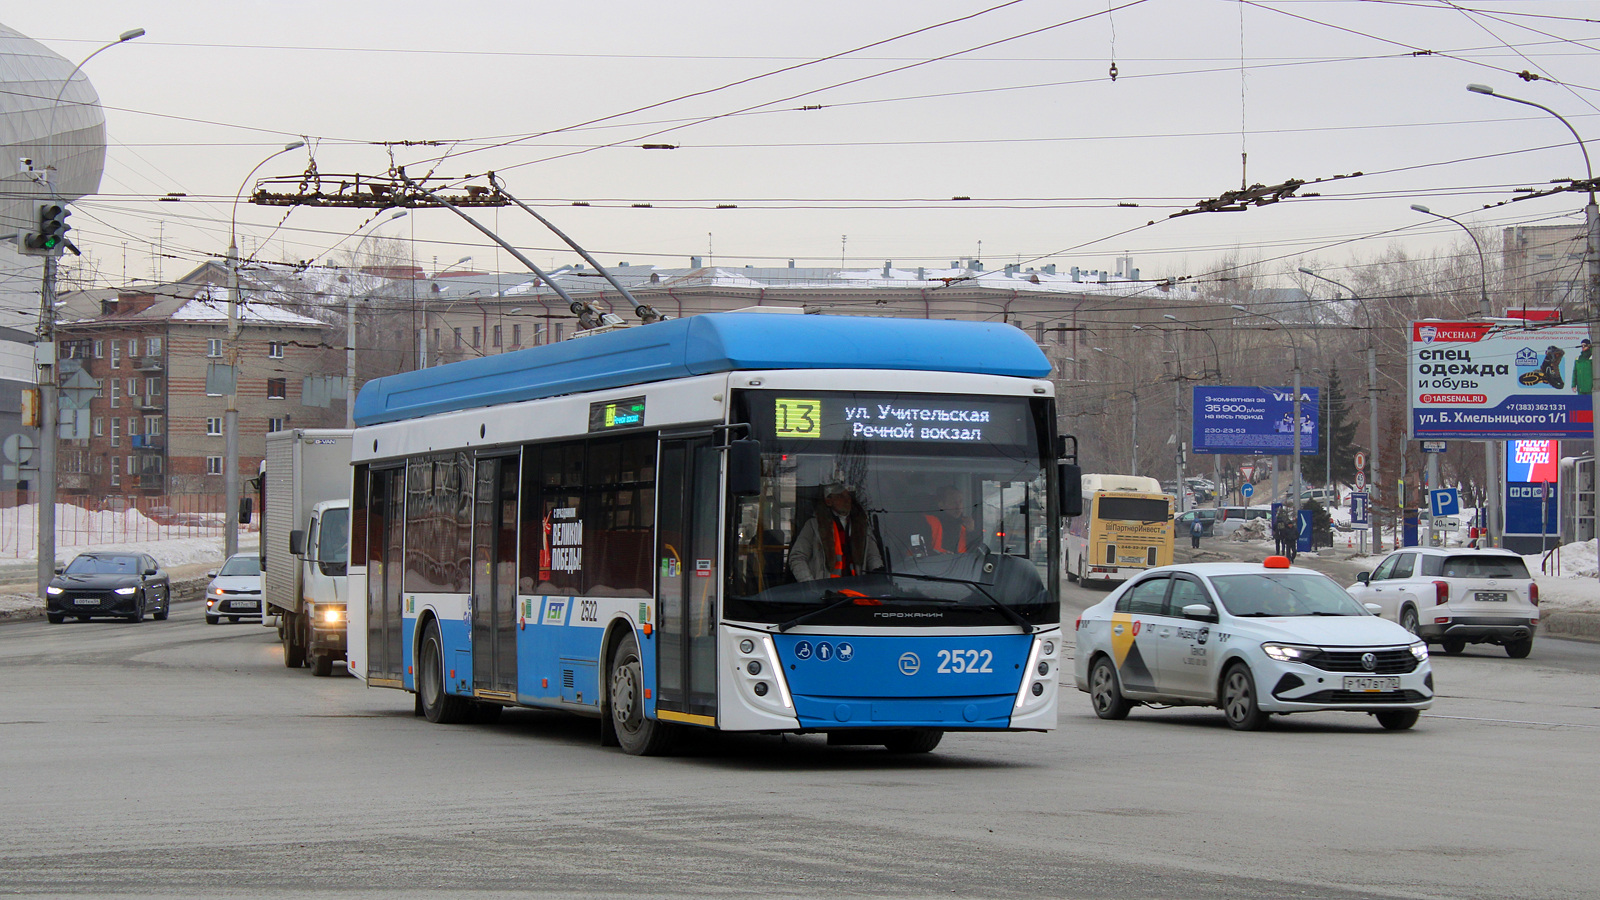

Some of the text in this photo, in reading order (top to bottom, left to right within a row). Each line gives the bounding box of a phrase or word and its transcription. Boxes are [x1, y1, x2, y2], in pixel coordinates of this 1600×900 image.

[1436, 331, 1477, 339] АРСЕНАЛ
[1419, 349, 1471, 362] спец
[1419, 364, 1509, 376] одежда
[1419, 378, 1479, 391] и обувь
[1433, 395, 1484, 403] 1ARSENAL.RU
[845, 404, 990, 423] ул. Учительская
[1204, 404, 1221, 413] 35
[1222, 404, 1246, 413] 900
[1515, 403, 1535, 412] (383)
[778, 404, 816, 433] 13
[1419, 413, 1566, 426] ул. Б. Хмельницкого 1/1
[853, 422, 982, 440] Речной вокзал
[552, 519, 583, 547] ВЕЛИКОЙ
[1112, 524, 1161, 534] ПартнерИнвест
[551, 547, 582, 576] ПОБЕДЫ!
[580, 600, 598, 622] 2522
[937, 649, 993, 674] 2522
